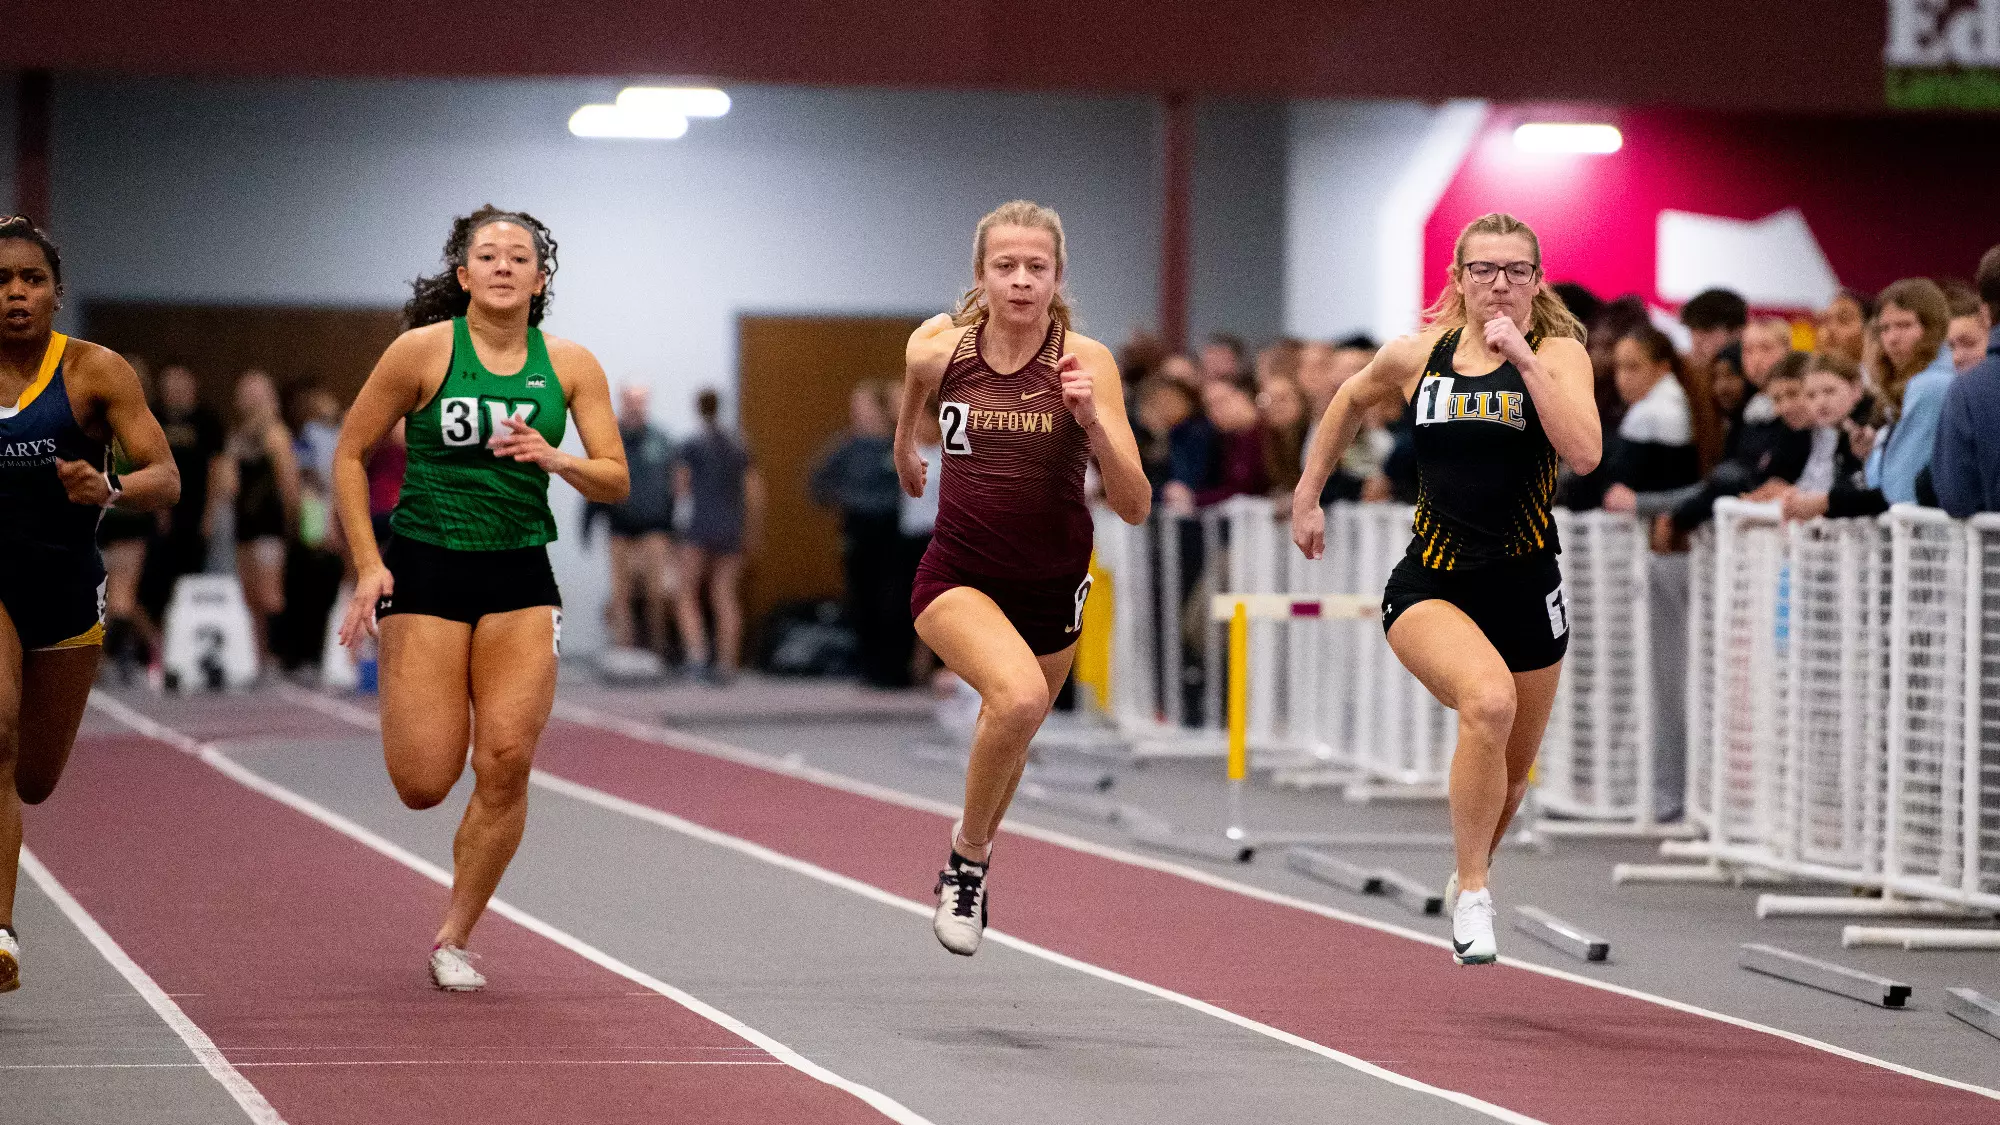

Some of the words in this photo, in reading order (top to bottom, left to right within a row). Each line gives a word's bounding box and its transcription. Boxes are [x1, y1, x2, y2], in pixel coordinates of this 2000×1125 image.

[1424, 379, 1441, 420] 1
[446, 401, 471, 442] 3
[942, 405, 966, 451] 2
[970, 410, 1053, 433] TZTOWN
[0, 438, 57, 457] ARY'S
[1551, 589, 1567, 630] 1
